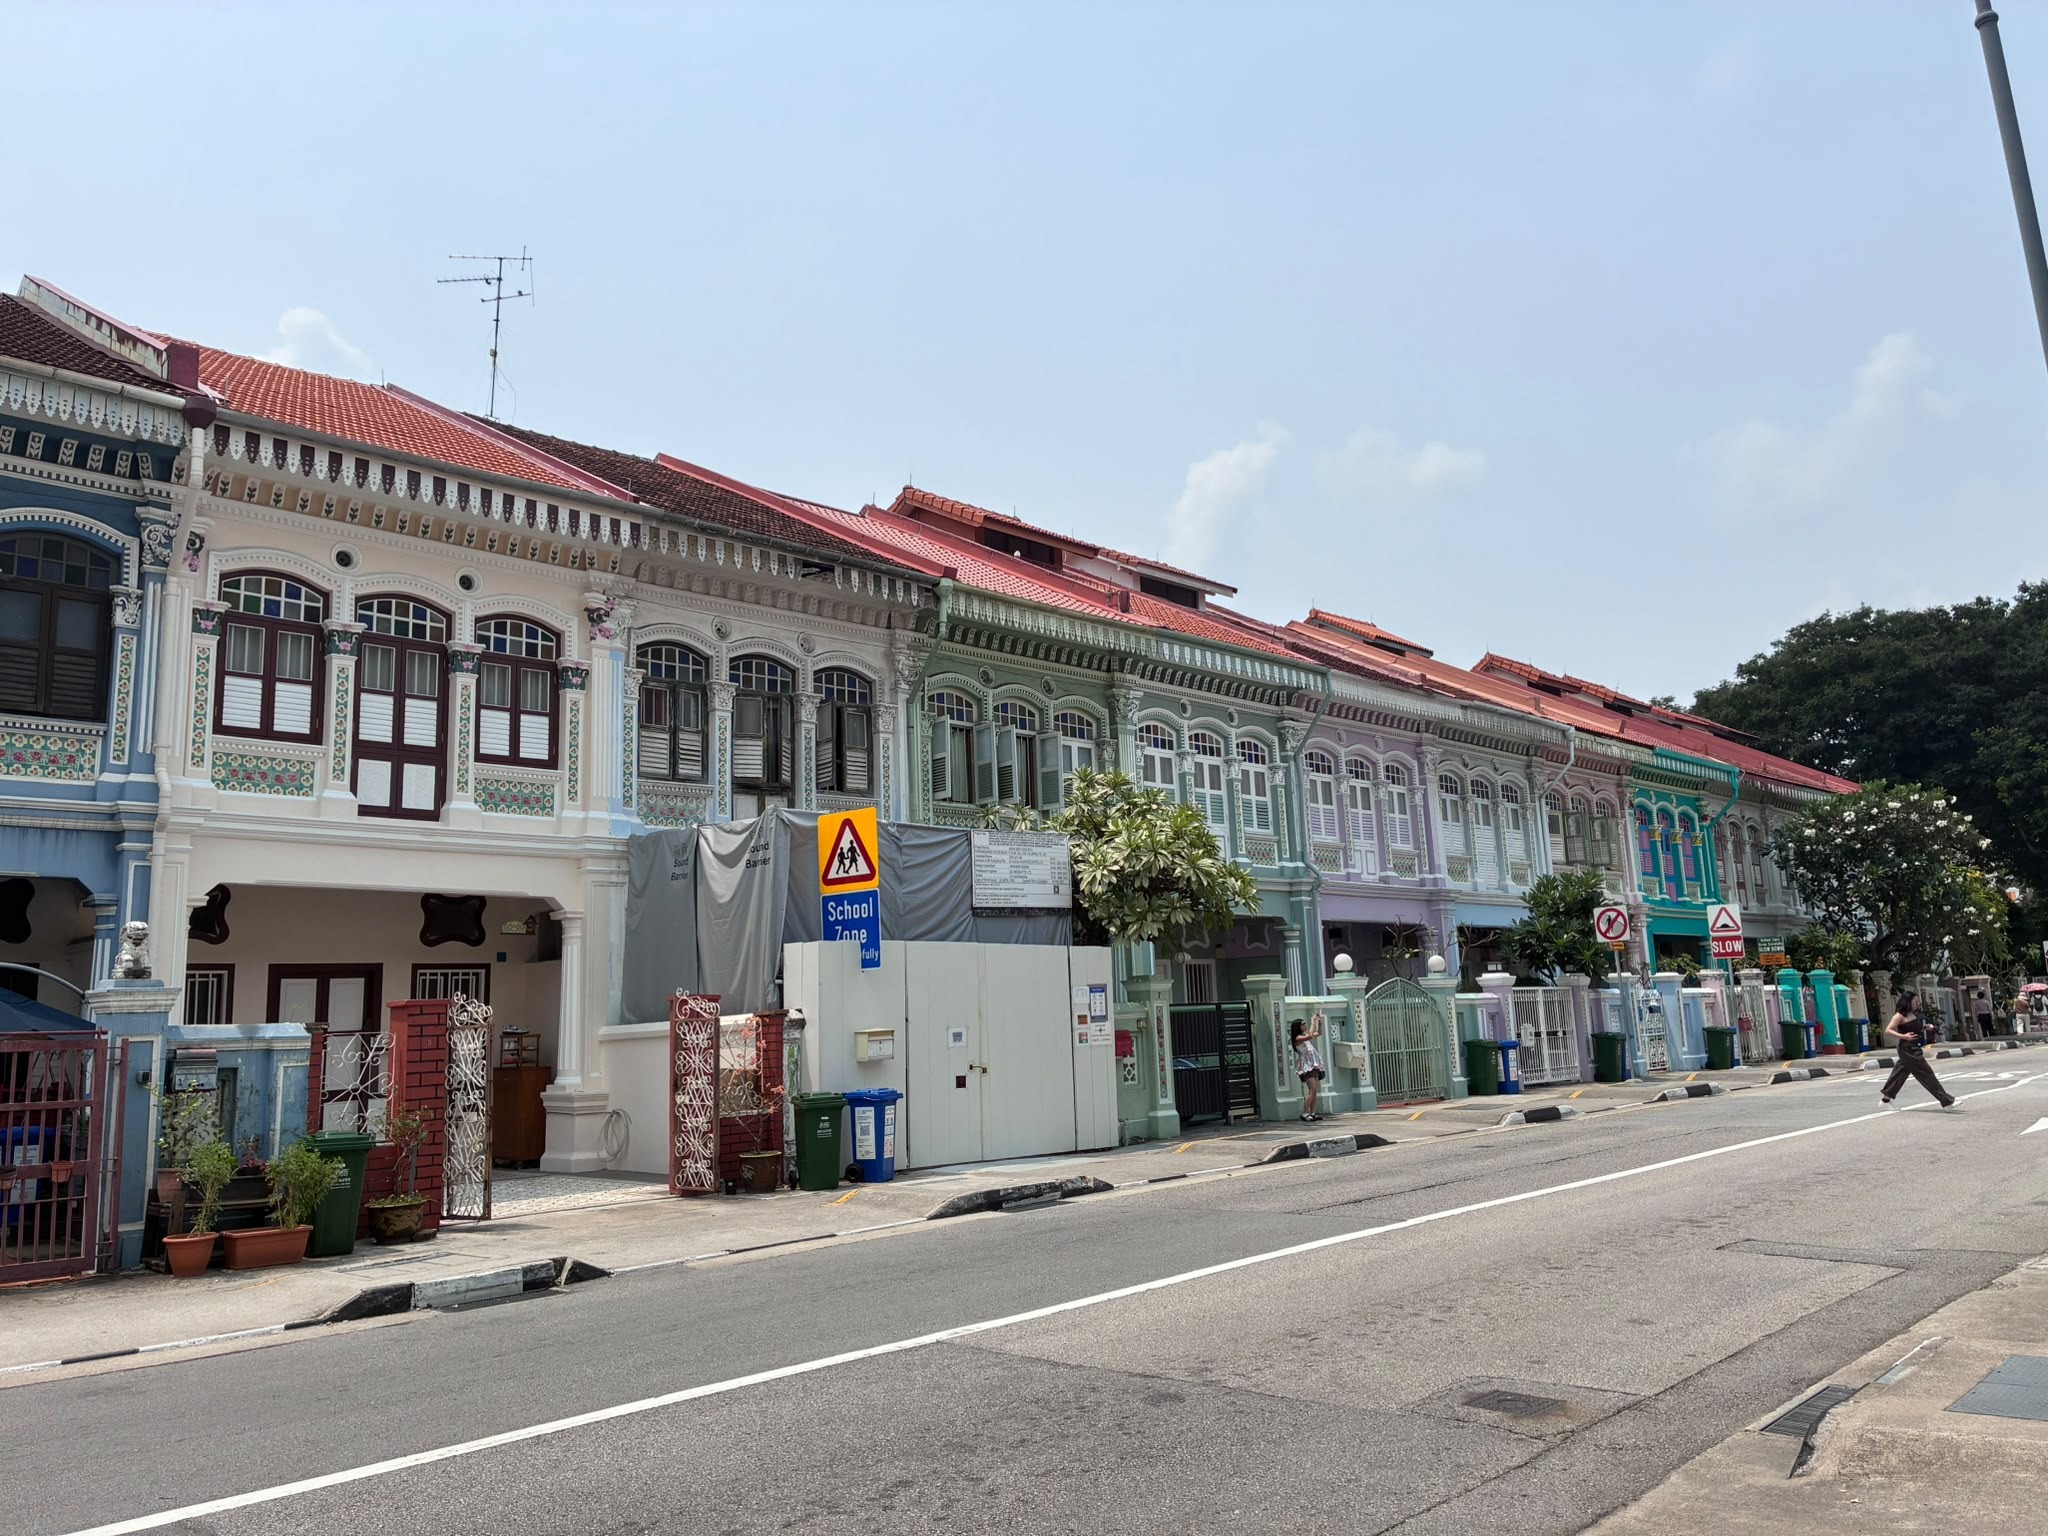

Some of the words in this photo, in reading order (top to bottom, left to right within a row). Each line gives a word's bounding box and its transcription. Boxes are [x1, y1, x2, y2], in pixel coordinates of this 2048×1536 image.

[748, 841, 769, 854] ound
[673, 857, 689, 867] Sound
[670, 872, 689, 882] Barrier
[828, 897, 873, 921] School
[834, 926, 867, 943] Zone
[1712, 940, 1742, 953] SLOW
[862, 947, 879, 962] fully
